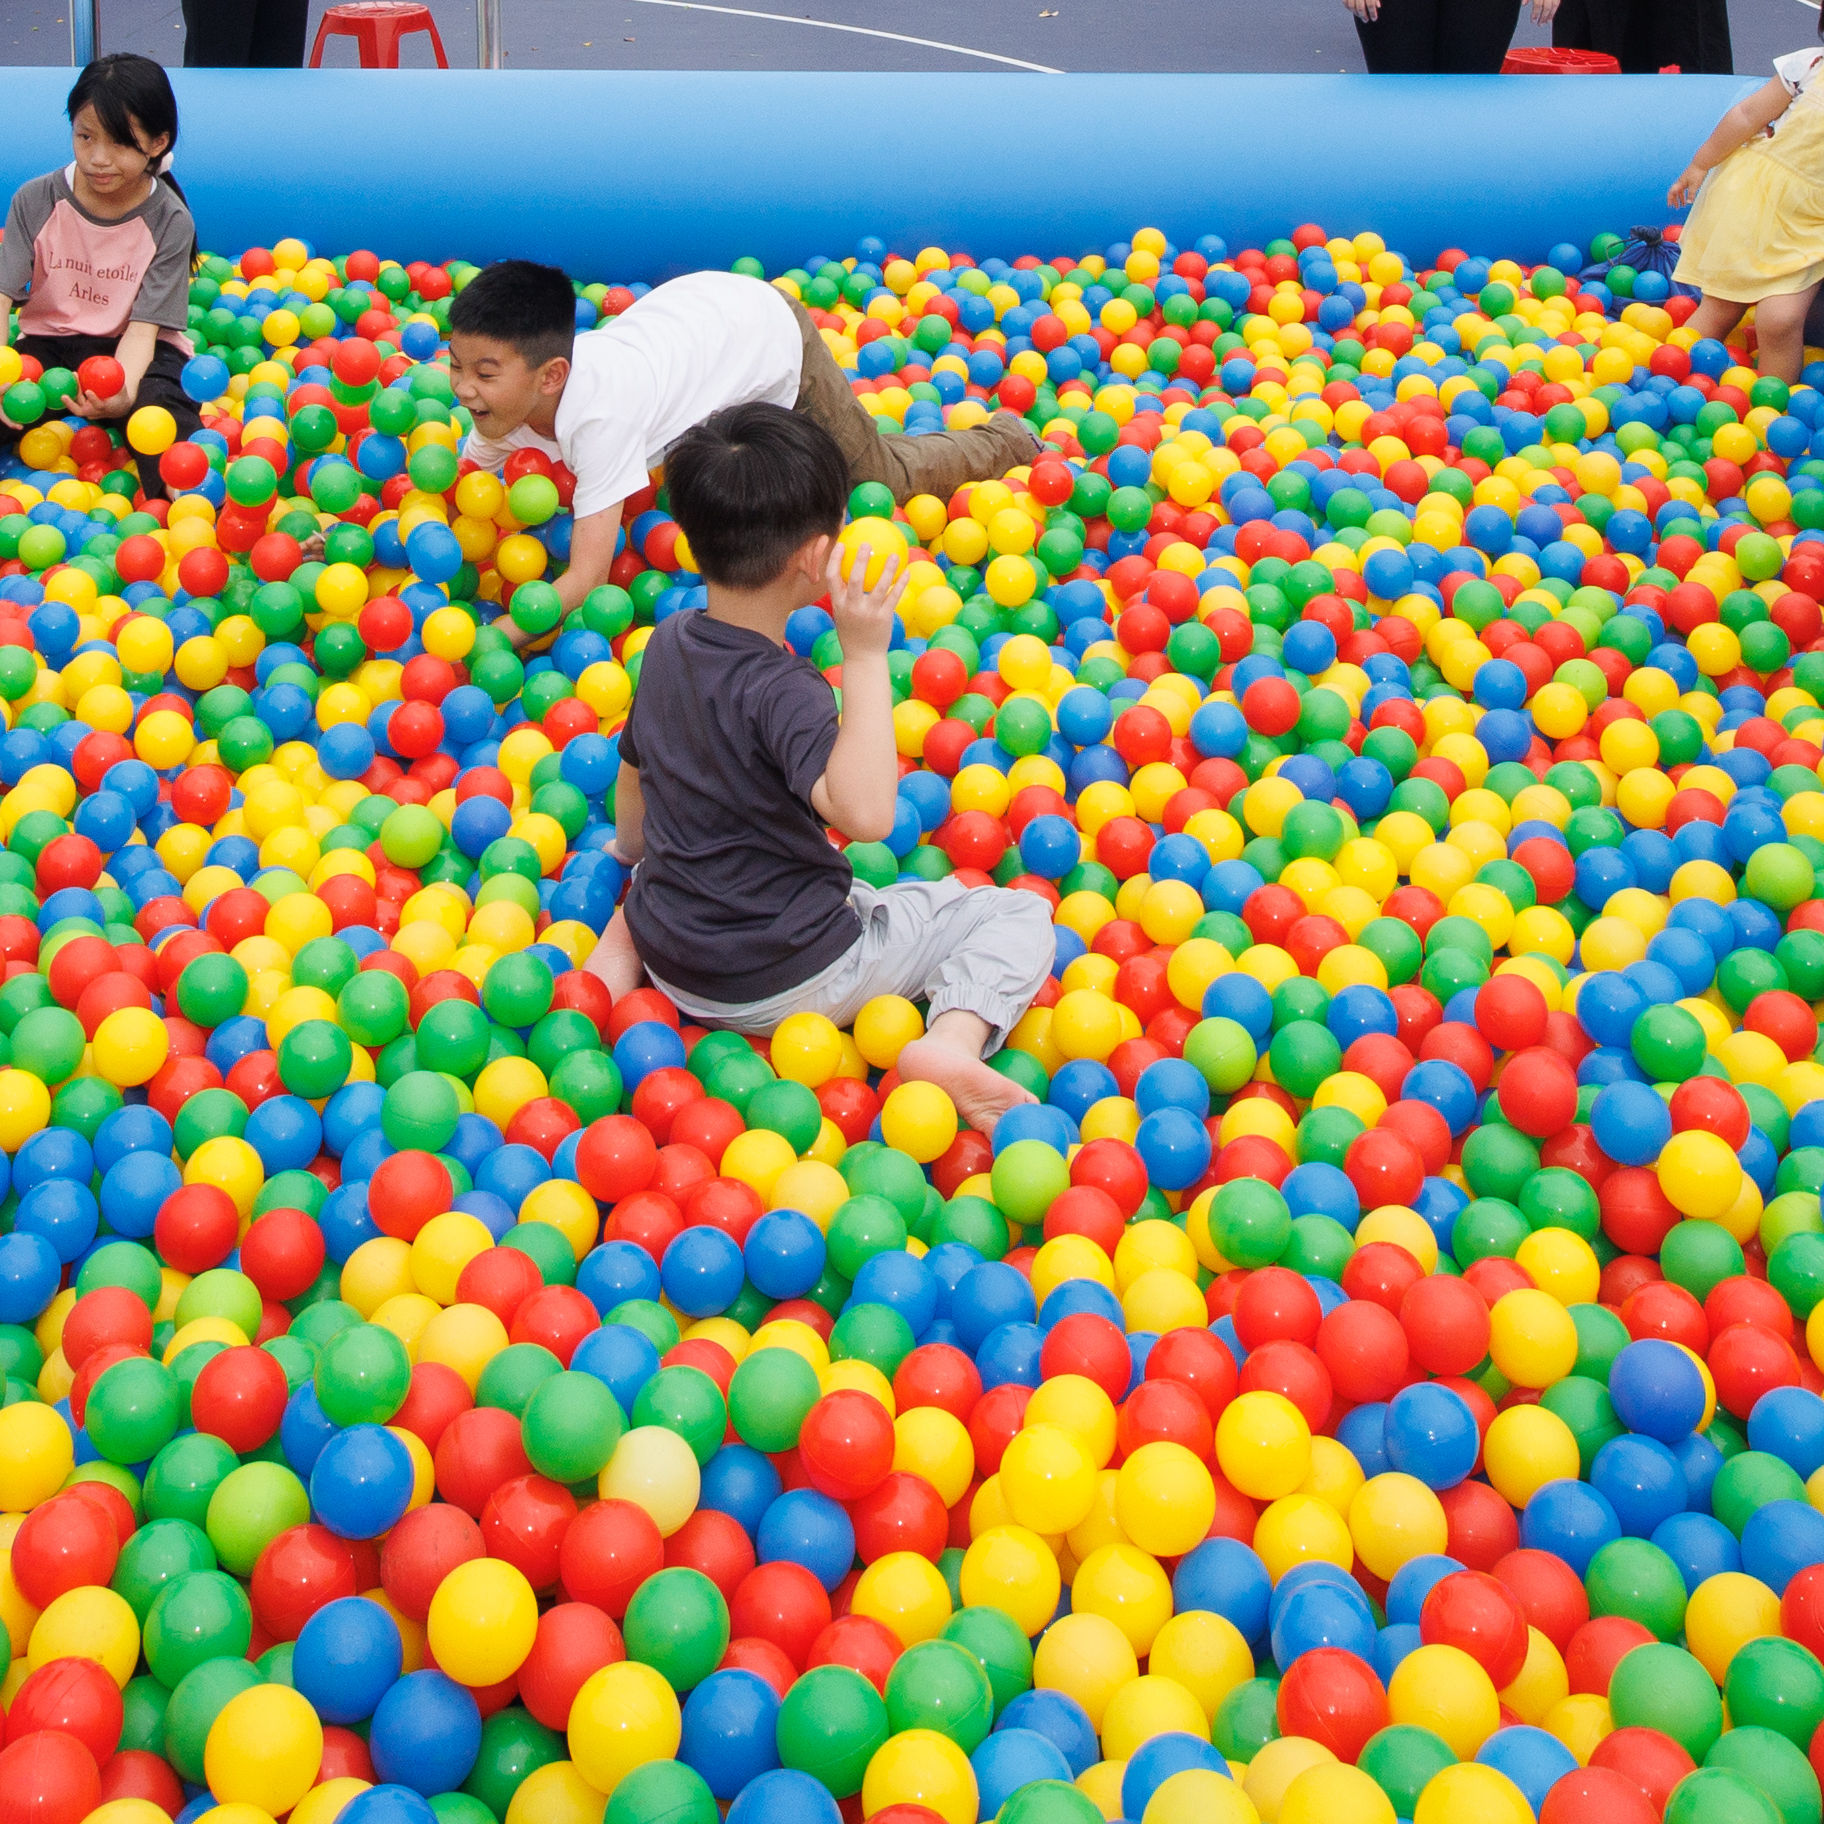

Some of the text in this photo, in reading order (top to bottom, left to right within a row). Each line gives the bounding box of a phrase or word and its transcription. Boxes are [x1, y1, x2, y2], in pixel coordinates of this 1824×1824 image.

[48, 251, 62, 269] La
[65, 257, 93, 275] nuit
[68, 281, 110, 306] Arles
